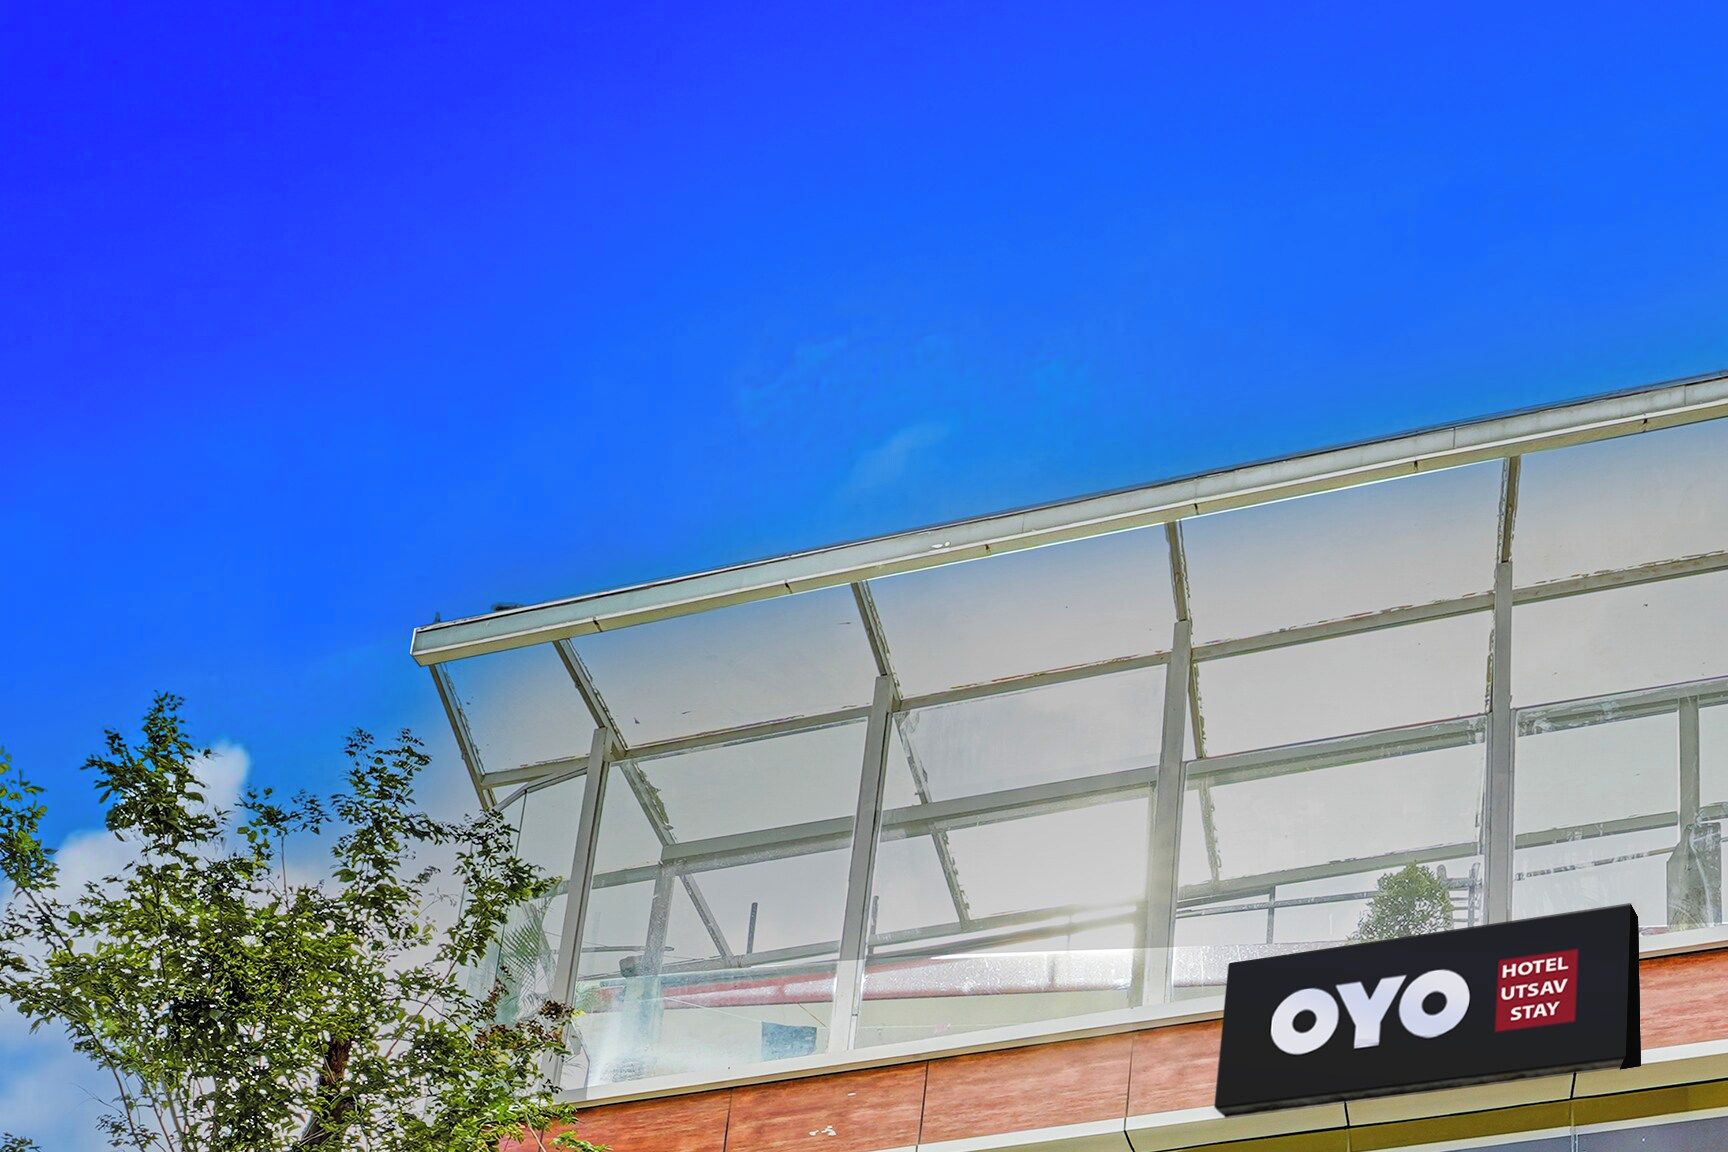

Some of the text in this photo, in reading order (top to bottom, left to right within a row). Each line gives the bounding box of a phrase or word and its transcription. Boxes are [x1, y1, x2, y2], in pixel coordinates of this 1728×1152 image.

[1502, 956, 1568, 978] HOTEL
[1501, 978, 1568, 1000] UTSAV
[1271, 969, 1470, 1055] OYO
[1510, 1001, 1560, 1021] STAY
